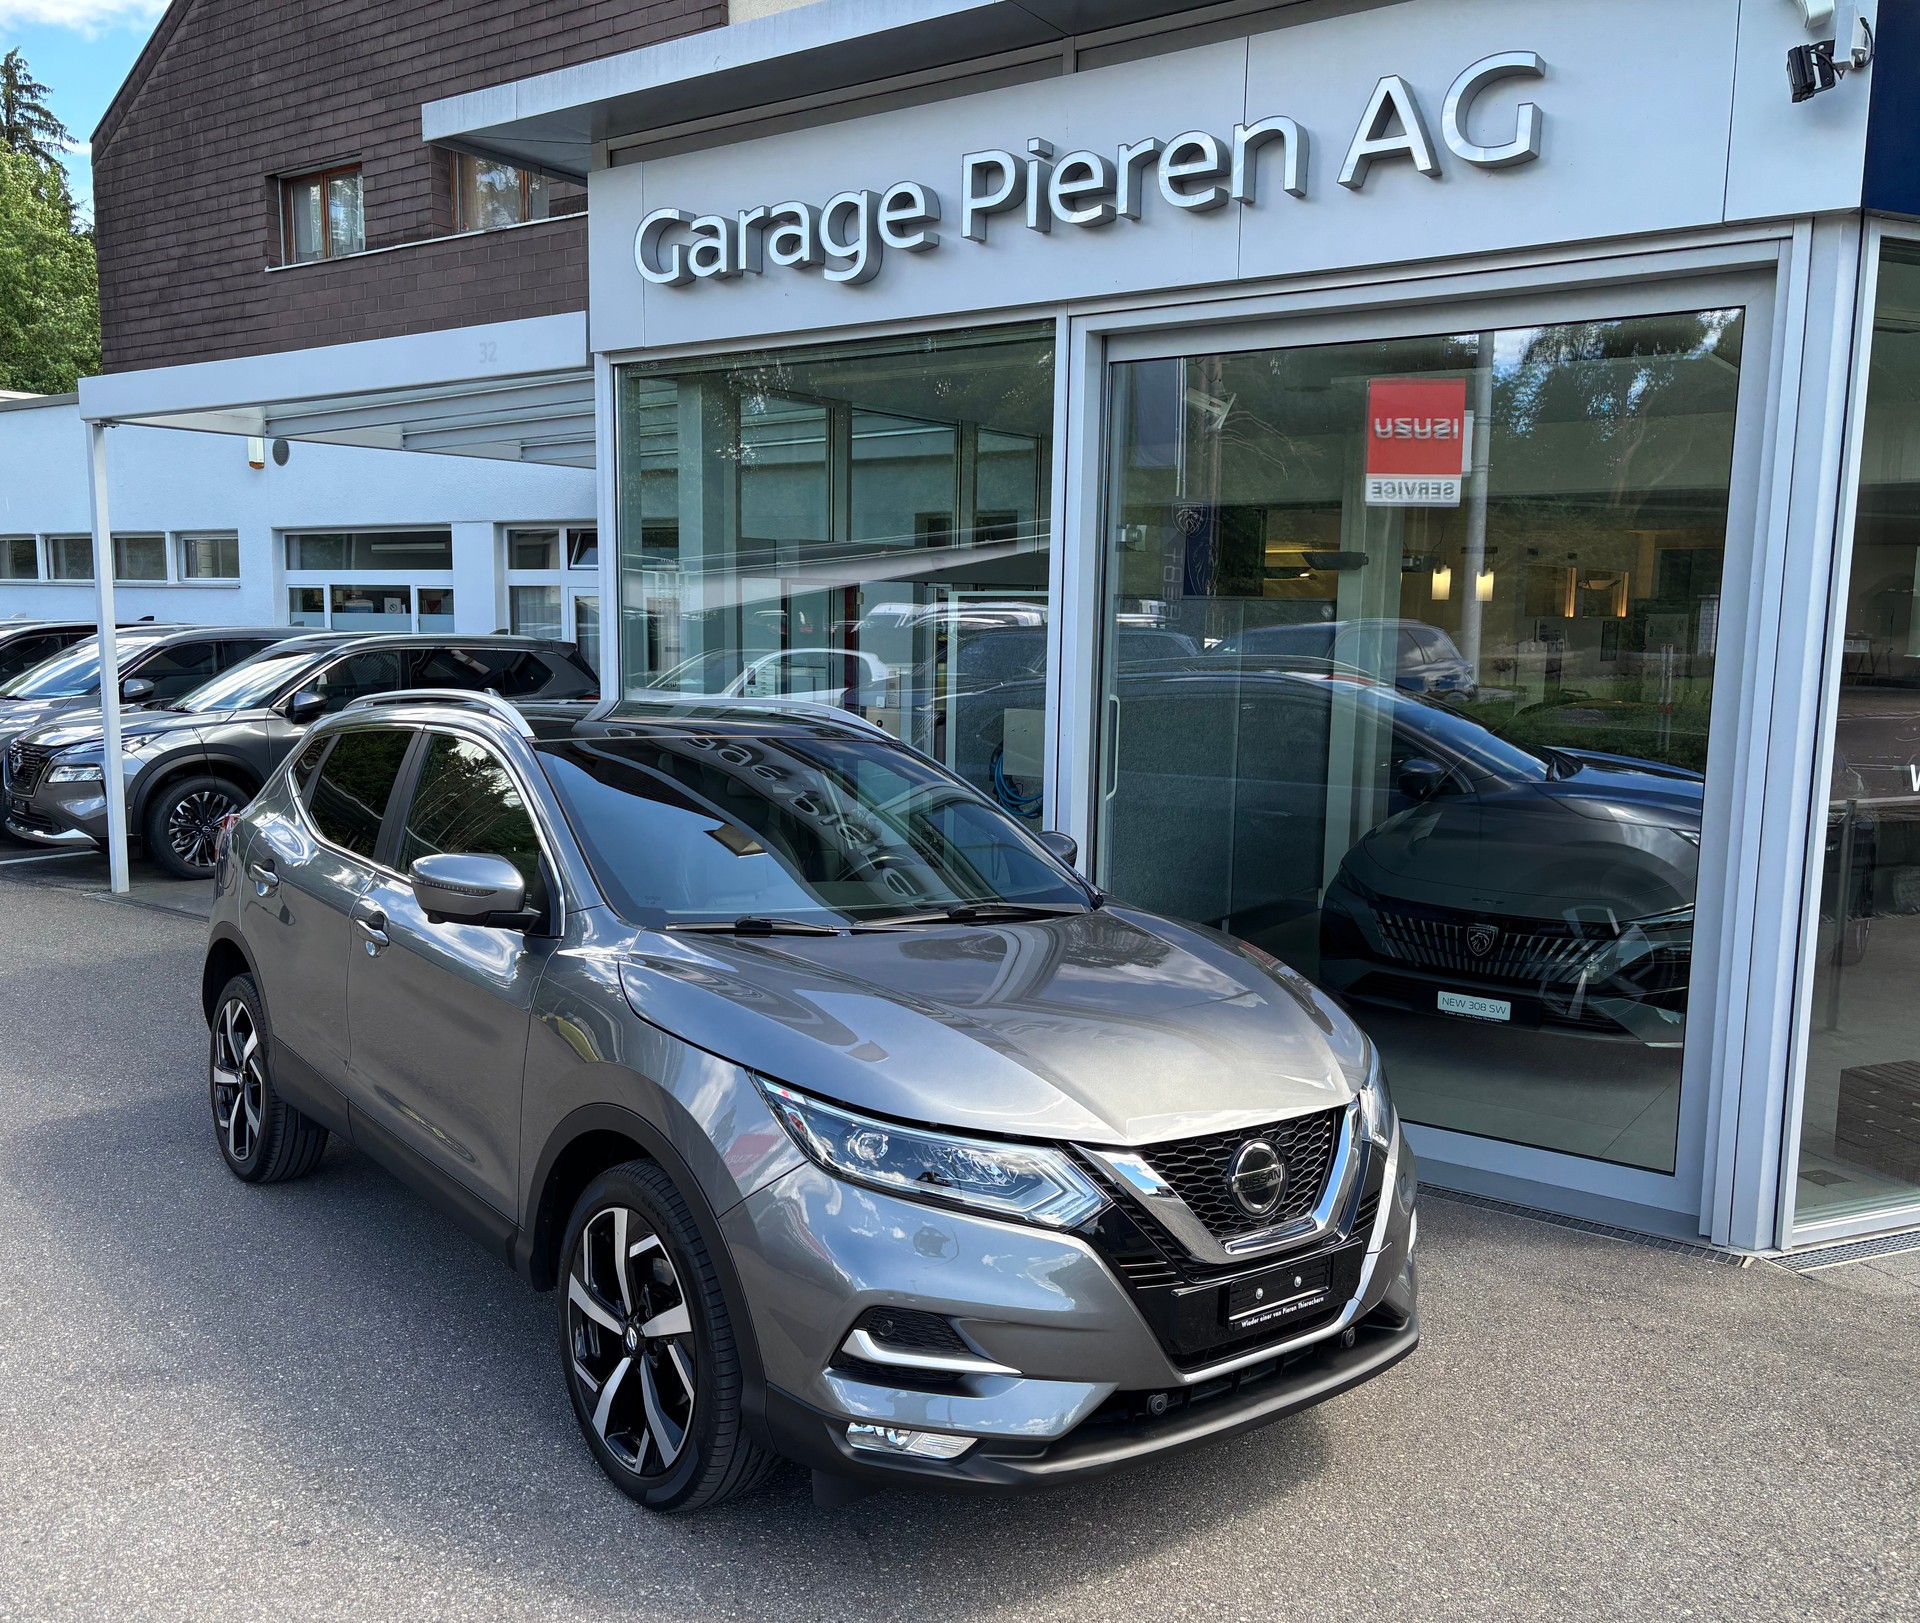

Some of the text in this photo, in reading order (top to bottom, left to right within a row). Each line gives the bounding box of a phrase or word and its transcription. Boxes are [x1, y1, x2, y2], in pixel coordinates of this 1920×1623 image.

[634, 50, 1546, 286] Garage Pieren AG
[479, 341, 497, 364] 32
[1442, 997, 1507, 1014] NEW 308 SW
[1240, 1168, 1280, 1189] NISSAN
[1241, 1318, 1259, 1327] Wieder
[1282, 1305, 1297, 1314] Pieren
